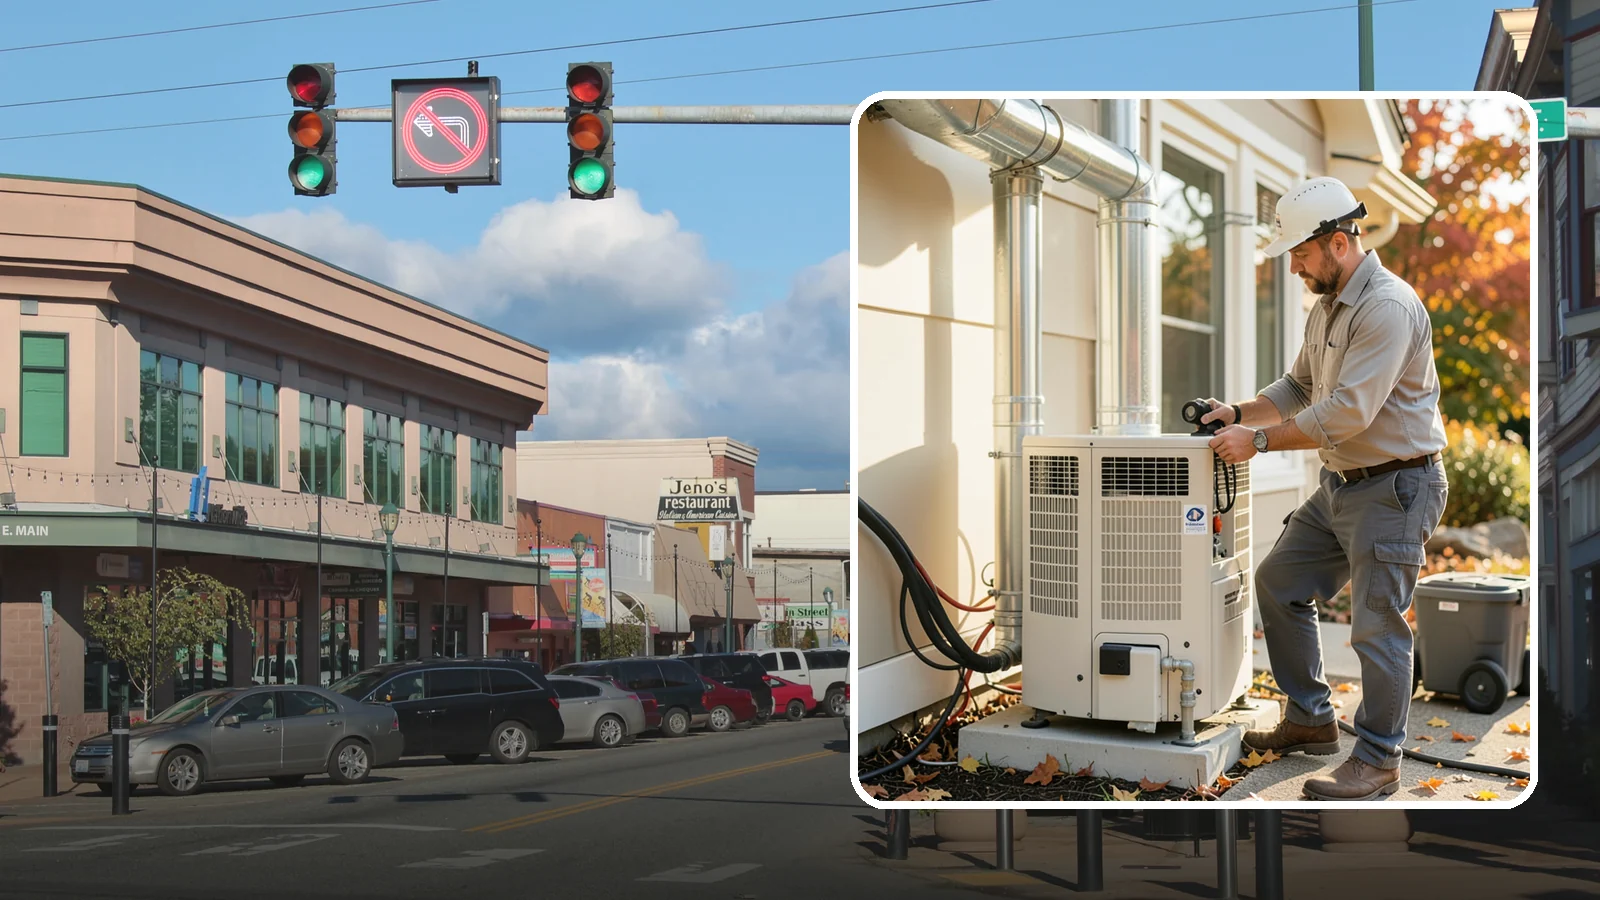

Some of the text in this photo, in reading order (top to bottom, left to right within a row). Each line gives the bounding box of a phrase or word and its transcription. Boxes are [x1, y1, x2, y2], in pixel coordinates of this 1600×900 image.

[670, 480, 727, 495] Jeno's
[665, 496, 731, 509] restaurant
[659, 509, 681, 519] Italian
[686, 509, 714, 519] American
[715, 509, 738, 519] Cuisine
[2, 525, 49, 536] E. MAIN
[797, 608, 828, 617] Street
[791, 619, 823, 627] lass
